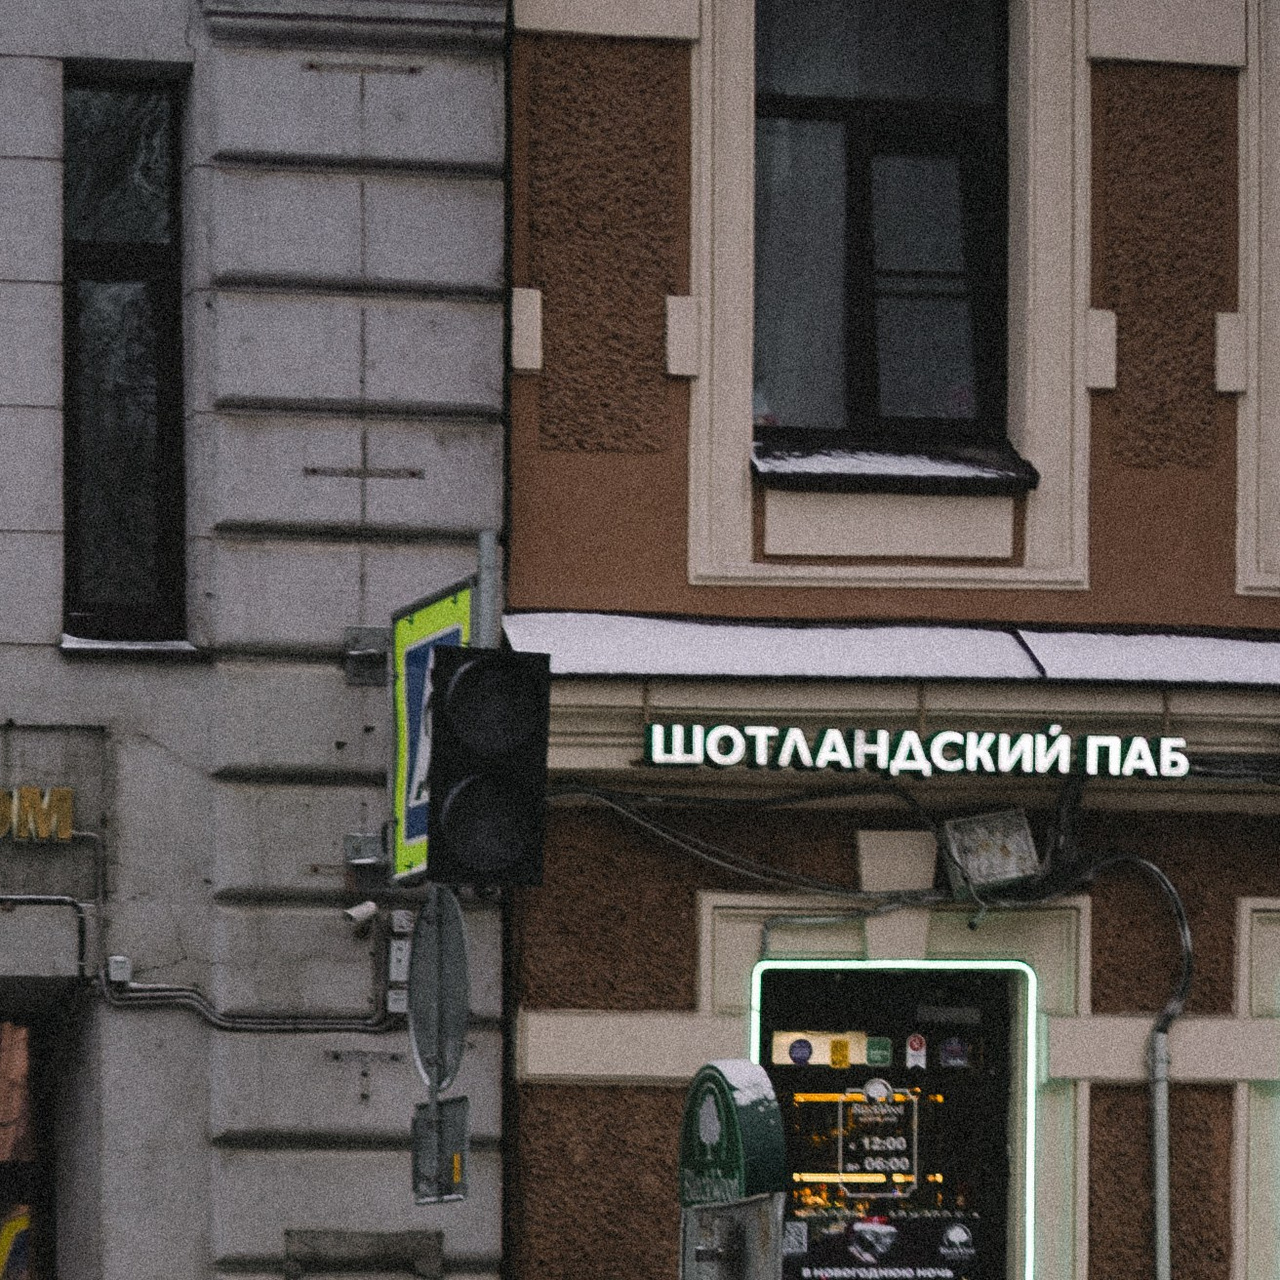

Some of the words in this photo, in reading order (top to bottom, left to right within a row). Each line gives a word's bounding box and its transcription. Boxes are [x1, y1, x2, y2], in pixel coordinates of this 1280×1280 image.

[650, 723, 1072, 777] ШОТЛАНДСКИЙ
[1085, 735, 1191, 779] ПАБ
[813, 1267, 915, 1279] НОВОГОДНЮЮ
